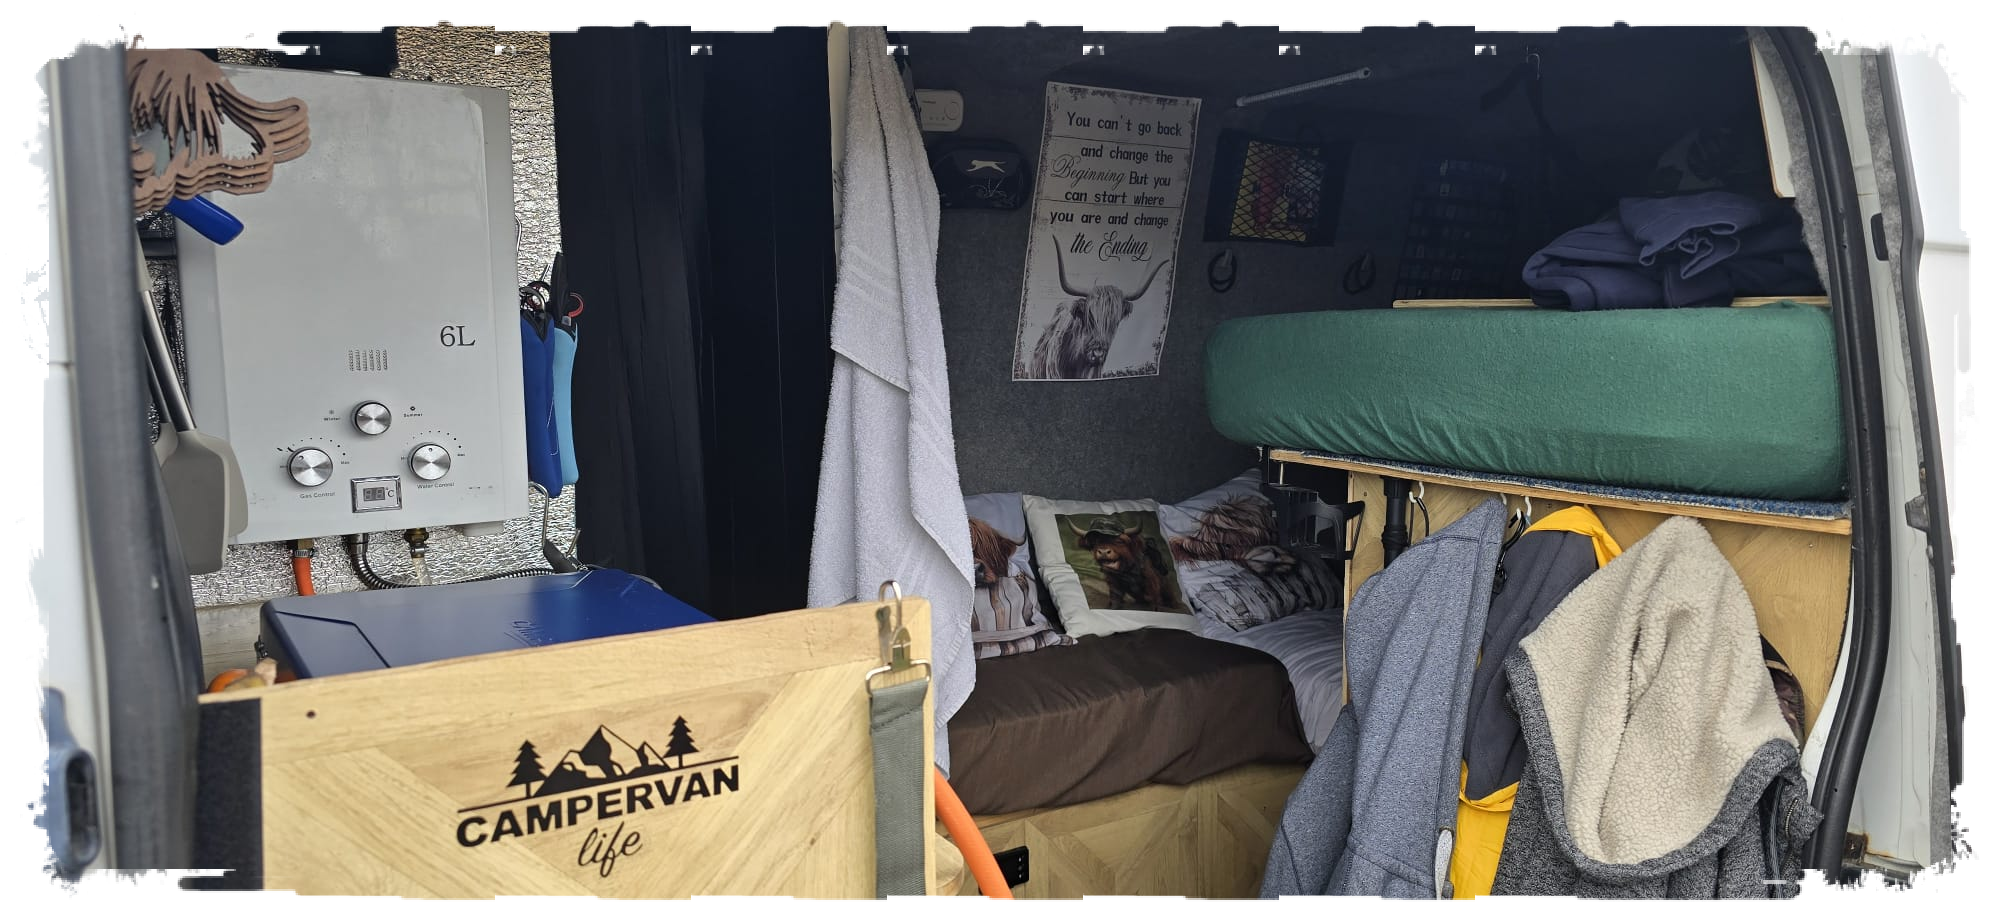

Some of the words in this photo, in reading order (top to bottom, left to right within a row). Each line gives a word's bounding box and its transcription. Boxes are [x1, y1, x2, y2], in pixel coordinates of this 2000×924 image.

[1067, 112, 1091, 128] You
[1097, 115, 1133, 132] can't
[1138, 122, 1152, 136] go
[1157, 121, 1182, 137] back
[1081, 144, 1103, 158] and
[1109, 146, 1149, 164] change
[1155, 150, 1173, 163] the
[1050, 154, 1126, 189] Beginning
[1129, 170, 1149, 186] But
[1153, 175, 1171, 190] you
[1064, 191, 1088, 202] can
[1094, 191, 1128, 204] start
[1133, 192, 1165, 206] where
[1050, 211, 1074, 225] you
[1081, 214, 1102, 224] are
[1108, 212, 1128, 225] and
[1134, 213, 1169, 229] change
[1070, 232, 1093, 254] the
[1098, 230, 1152, 262] Ending
[440, 325, 476, 347] 6L
[314, 491, 335, 499] Control
[456, 764, 740, 848] CAMPERVAN
[577, 820, 644, 879] life
